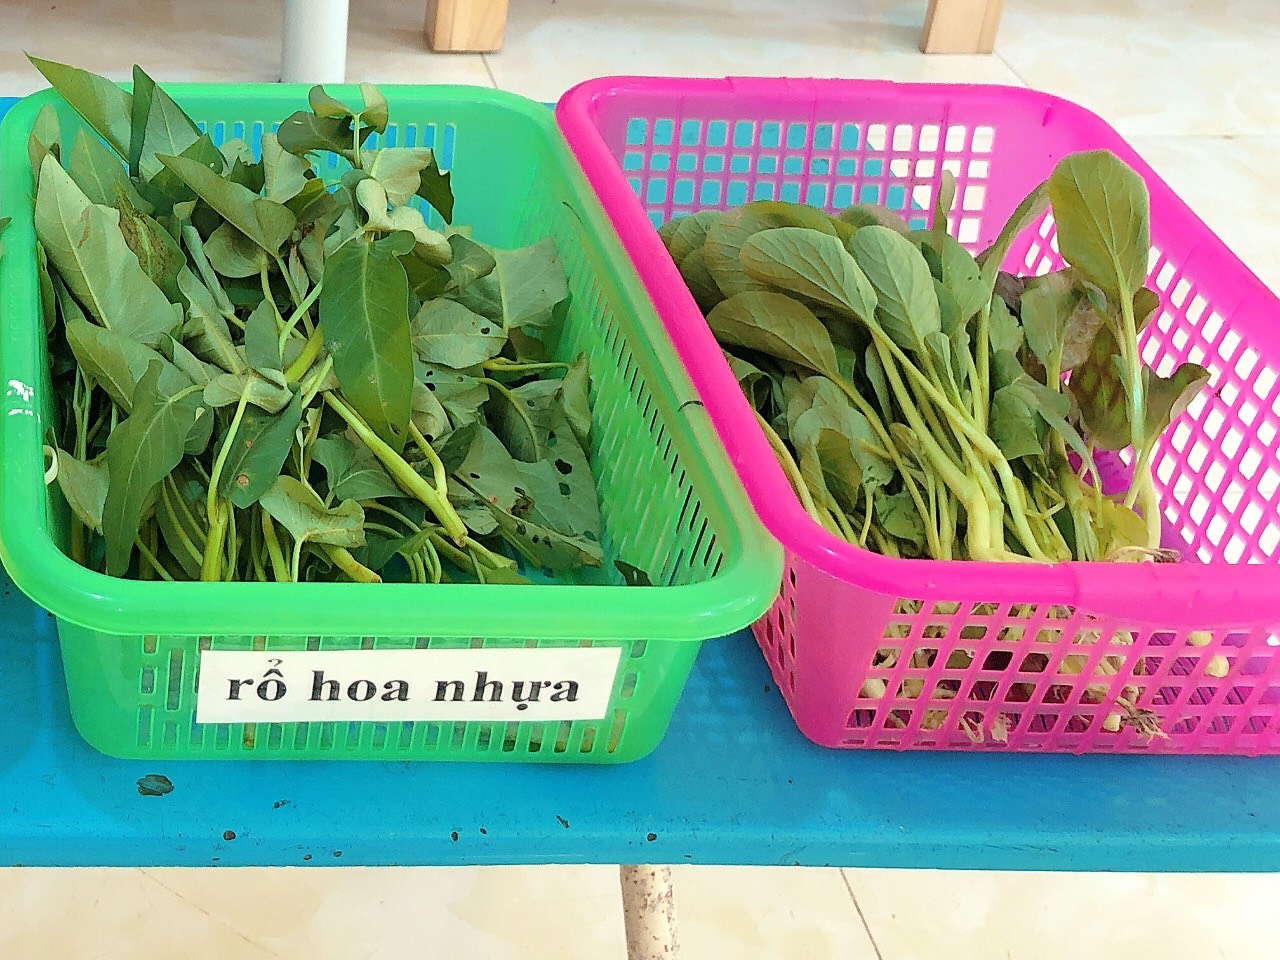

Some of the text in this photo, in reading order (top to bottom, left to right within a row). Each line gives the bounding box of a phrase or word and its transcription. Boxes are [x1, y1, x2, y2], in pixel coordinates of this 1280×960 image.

[225, 658, 580, 711] rổ hoa nhựa
